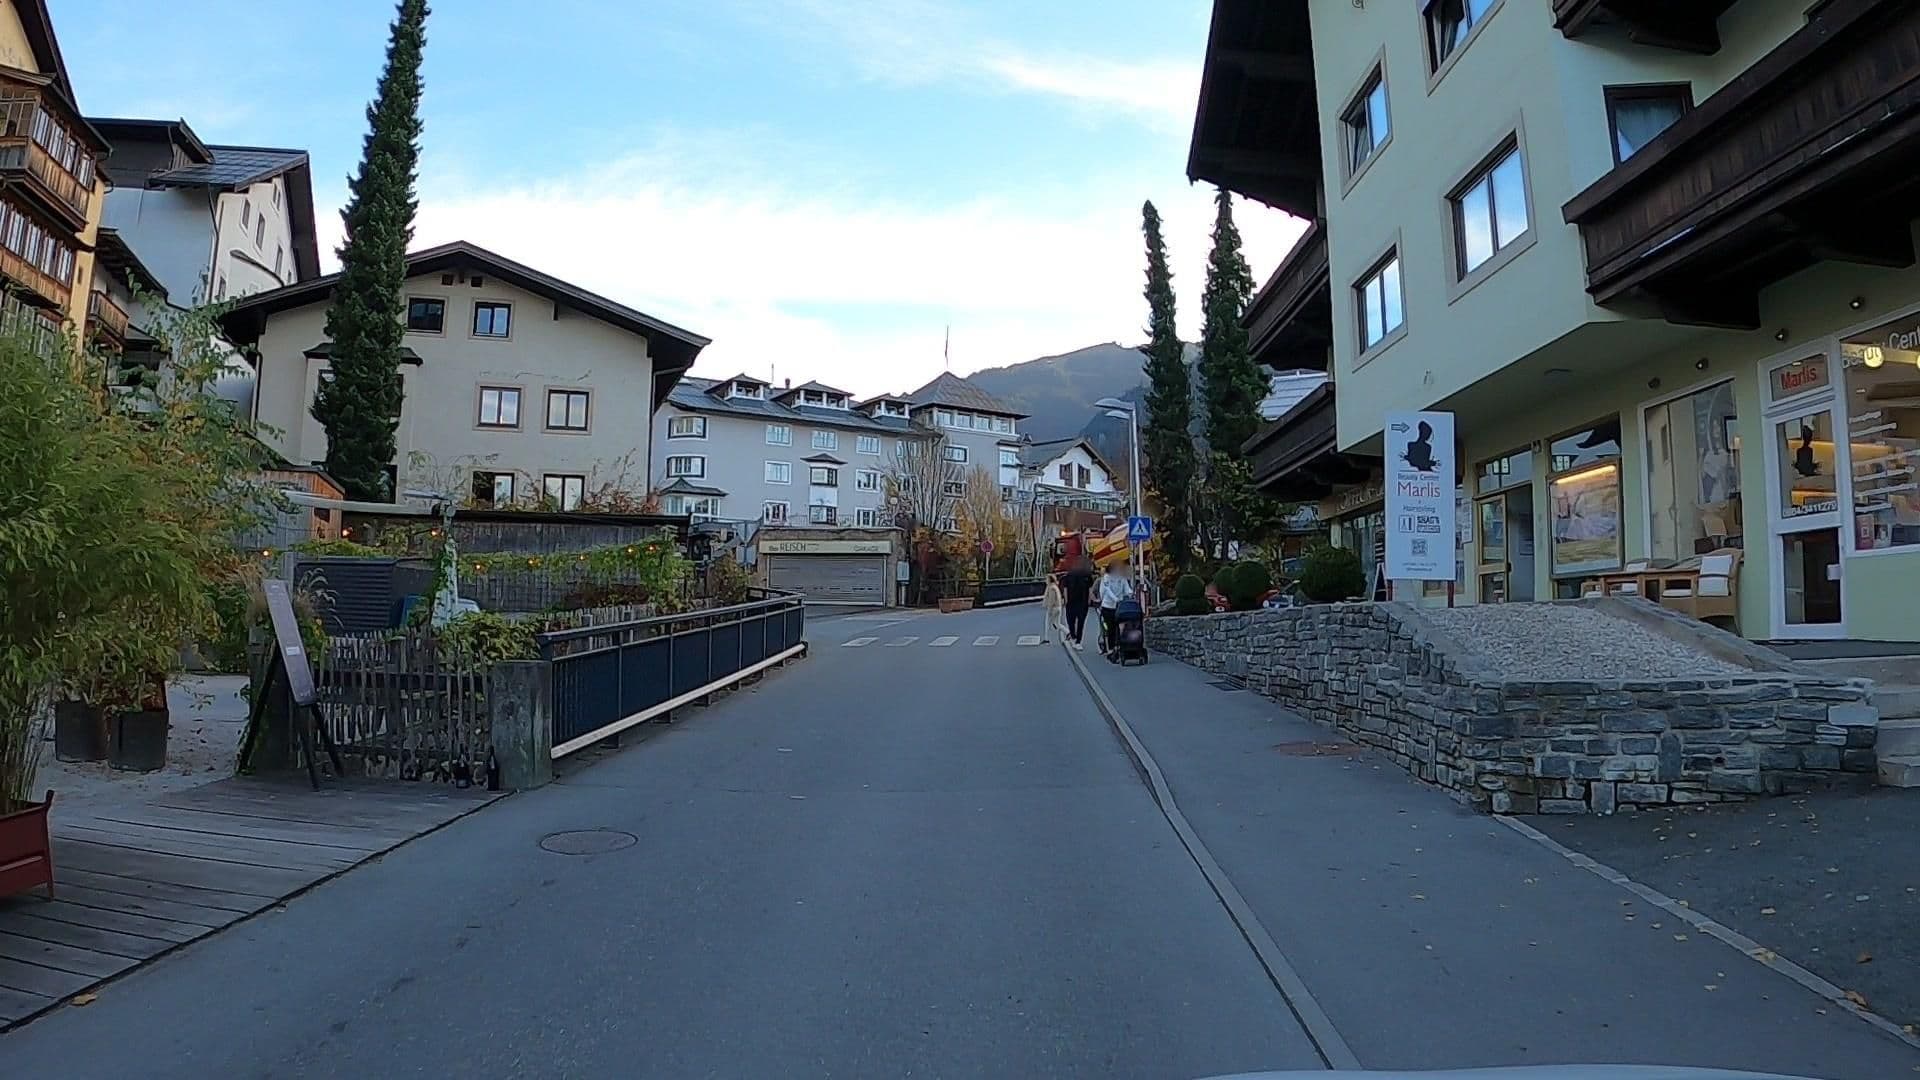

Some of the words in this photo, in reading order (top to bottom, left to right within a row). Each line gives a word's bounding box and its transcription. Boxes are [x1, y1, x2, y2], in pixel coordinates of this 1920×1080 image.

[1781, 366, 1817, 390] Marlis
[1397, 481, 1440, 497] Marlis
[780, 542, 806, 552] REISCH
